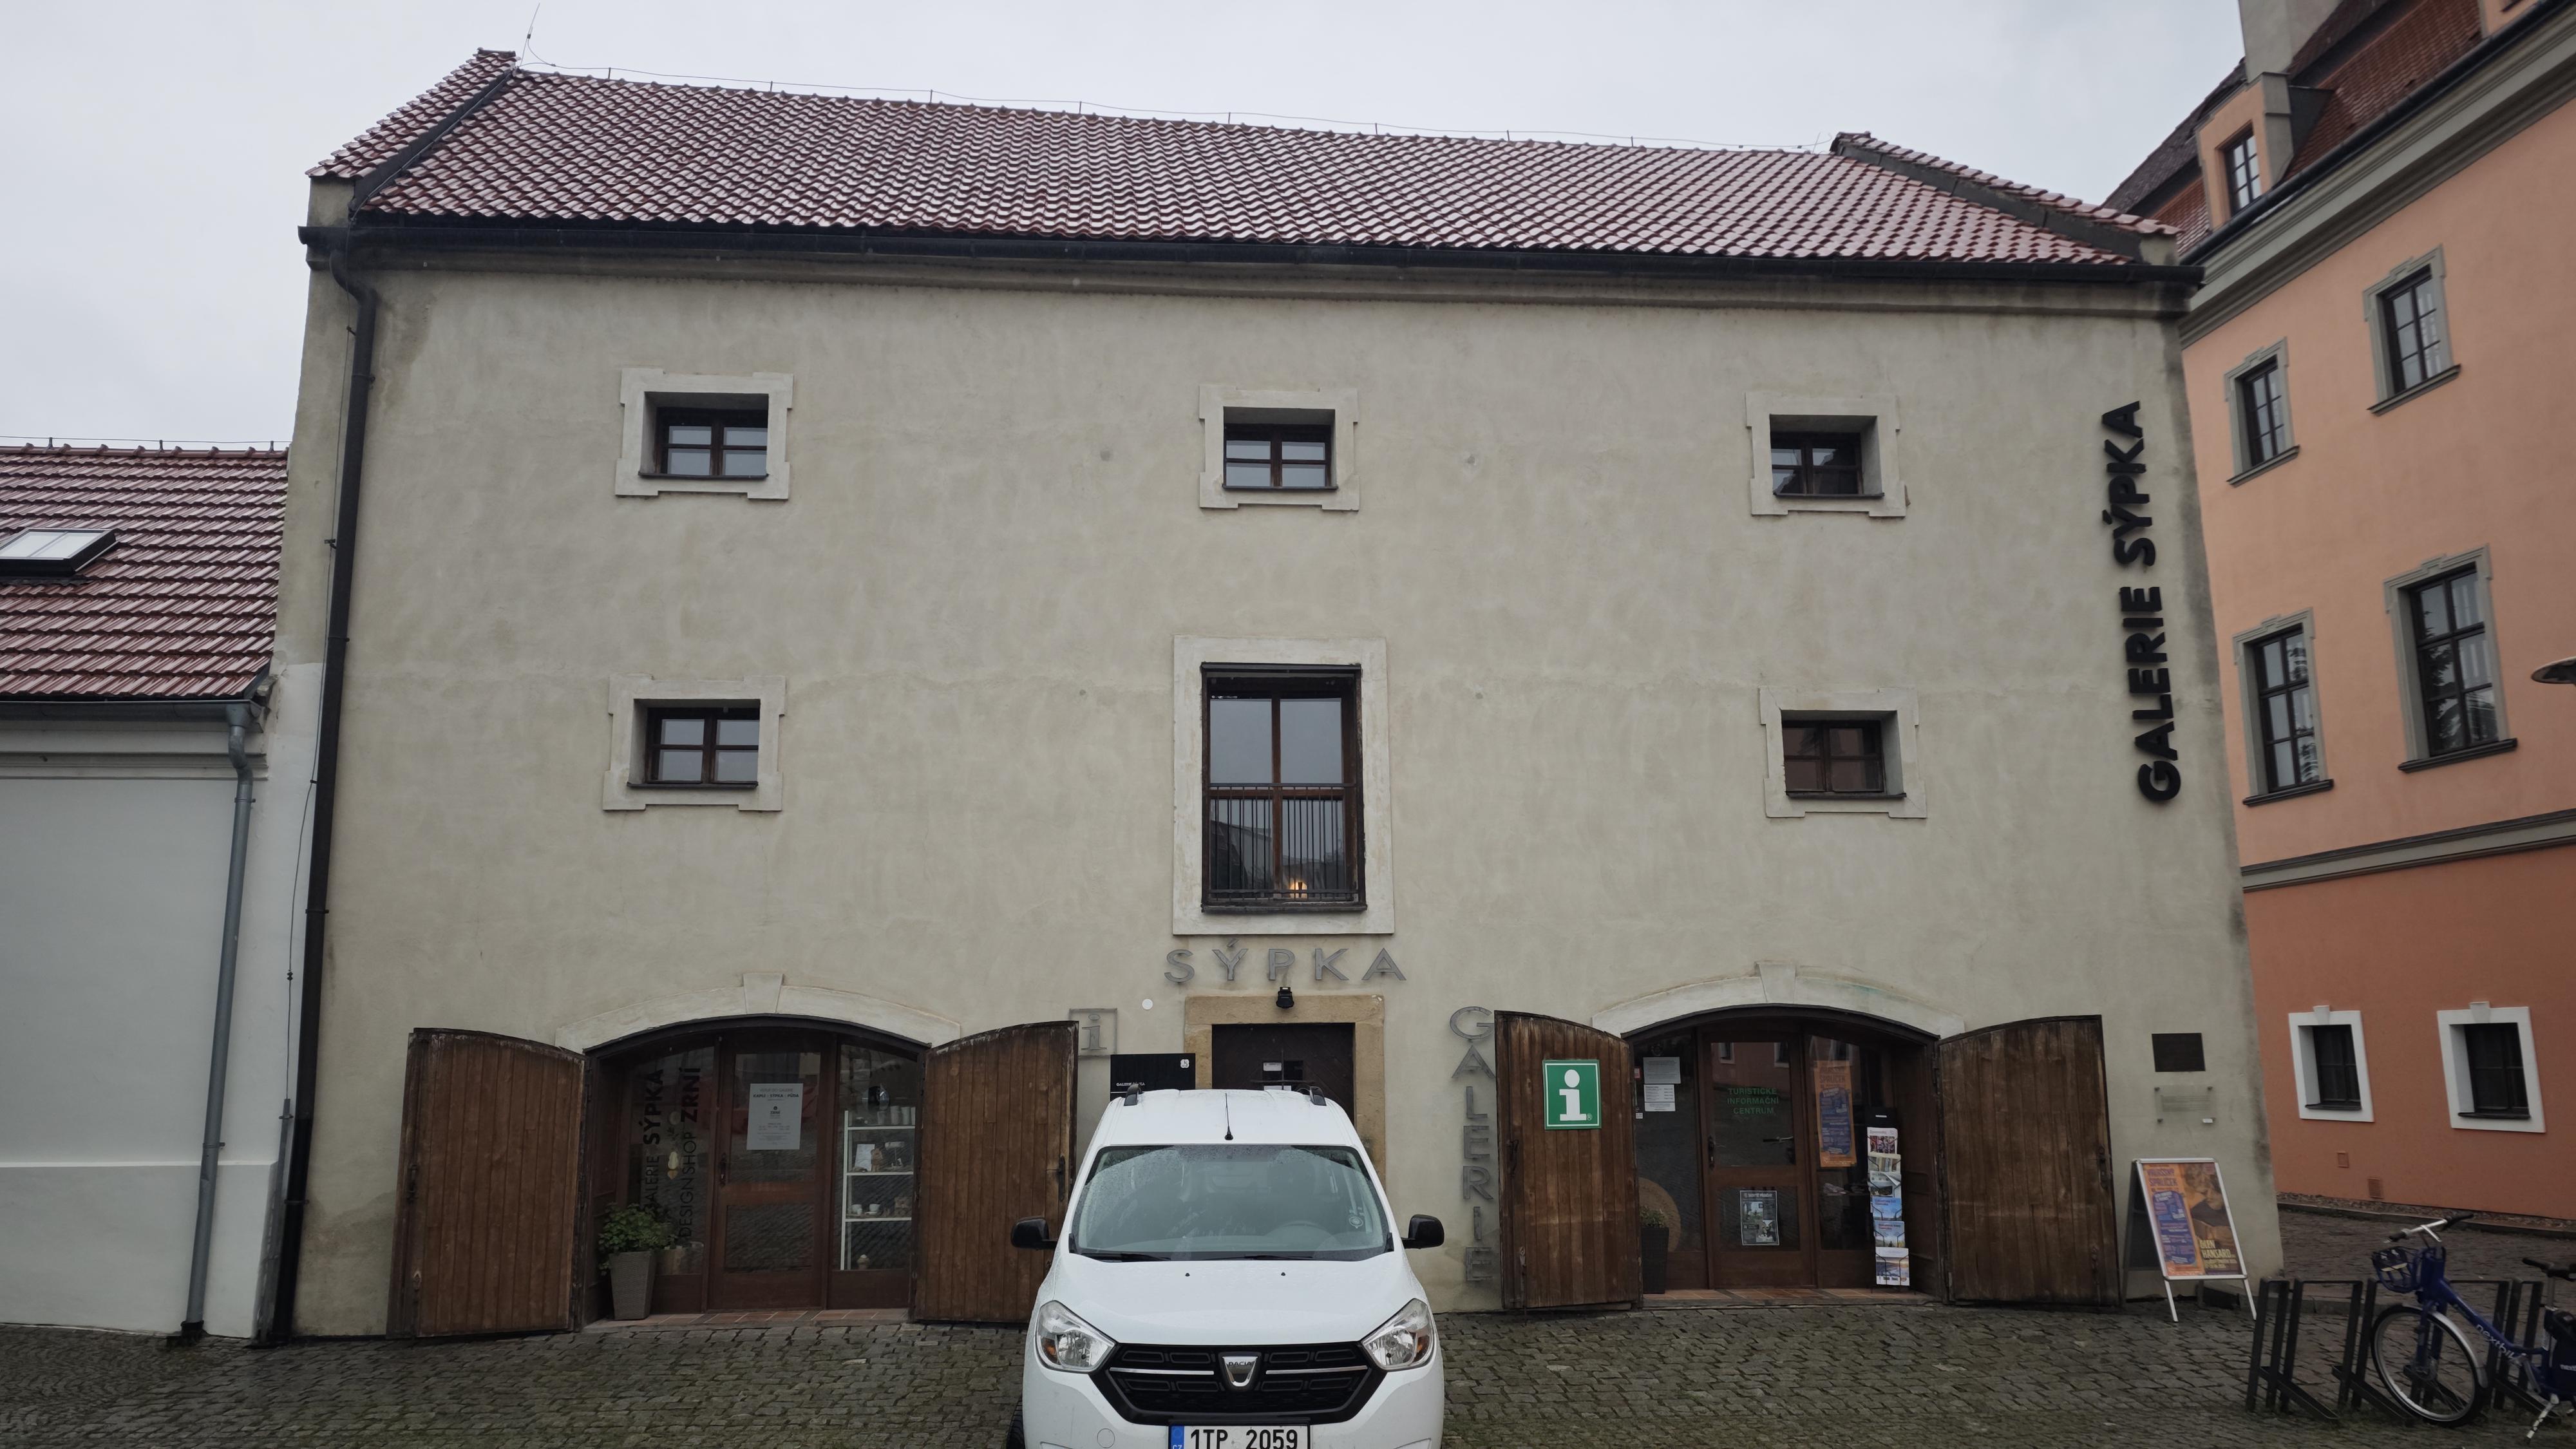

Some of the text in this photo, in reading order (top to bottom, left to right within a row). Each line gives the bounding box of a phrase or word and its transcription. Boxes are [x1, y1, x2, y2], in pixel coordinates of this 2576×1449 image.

[2101, 400, 2182, 802] GALERIE SÝPKA
[1164, 939, 1406, 983] SÝPKA
[1727, 1096, 1779, 1104] INFORMAČNÍ
[677, 1066, 701, 1238] DESIGN SHOP ZRNÍ
[1449, 1006, 1496, 1283] GALERIE
[2201, 1249, 2231, 1258] HANSARD
[1190, 1429, 1298, 1449] 1TP 2059
